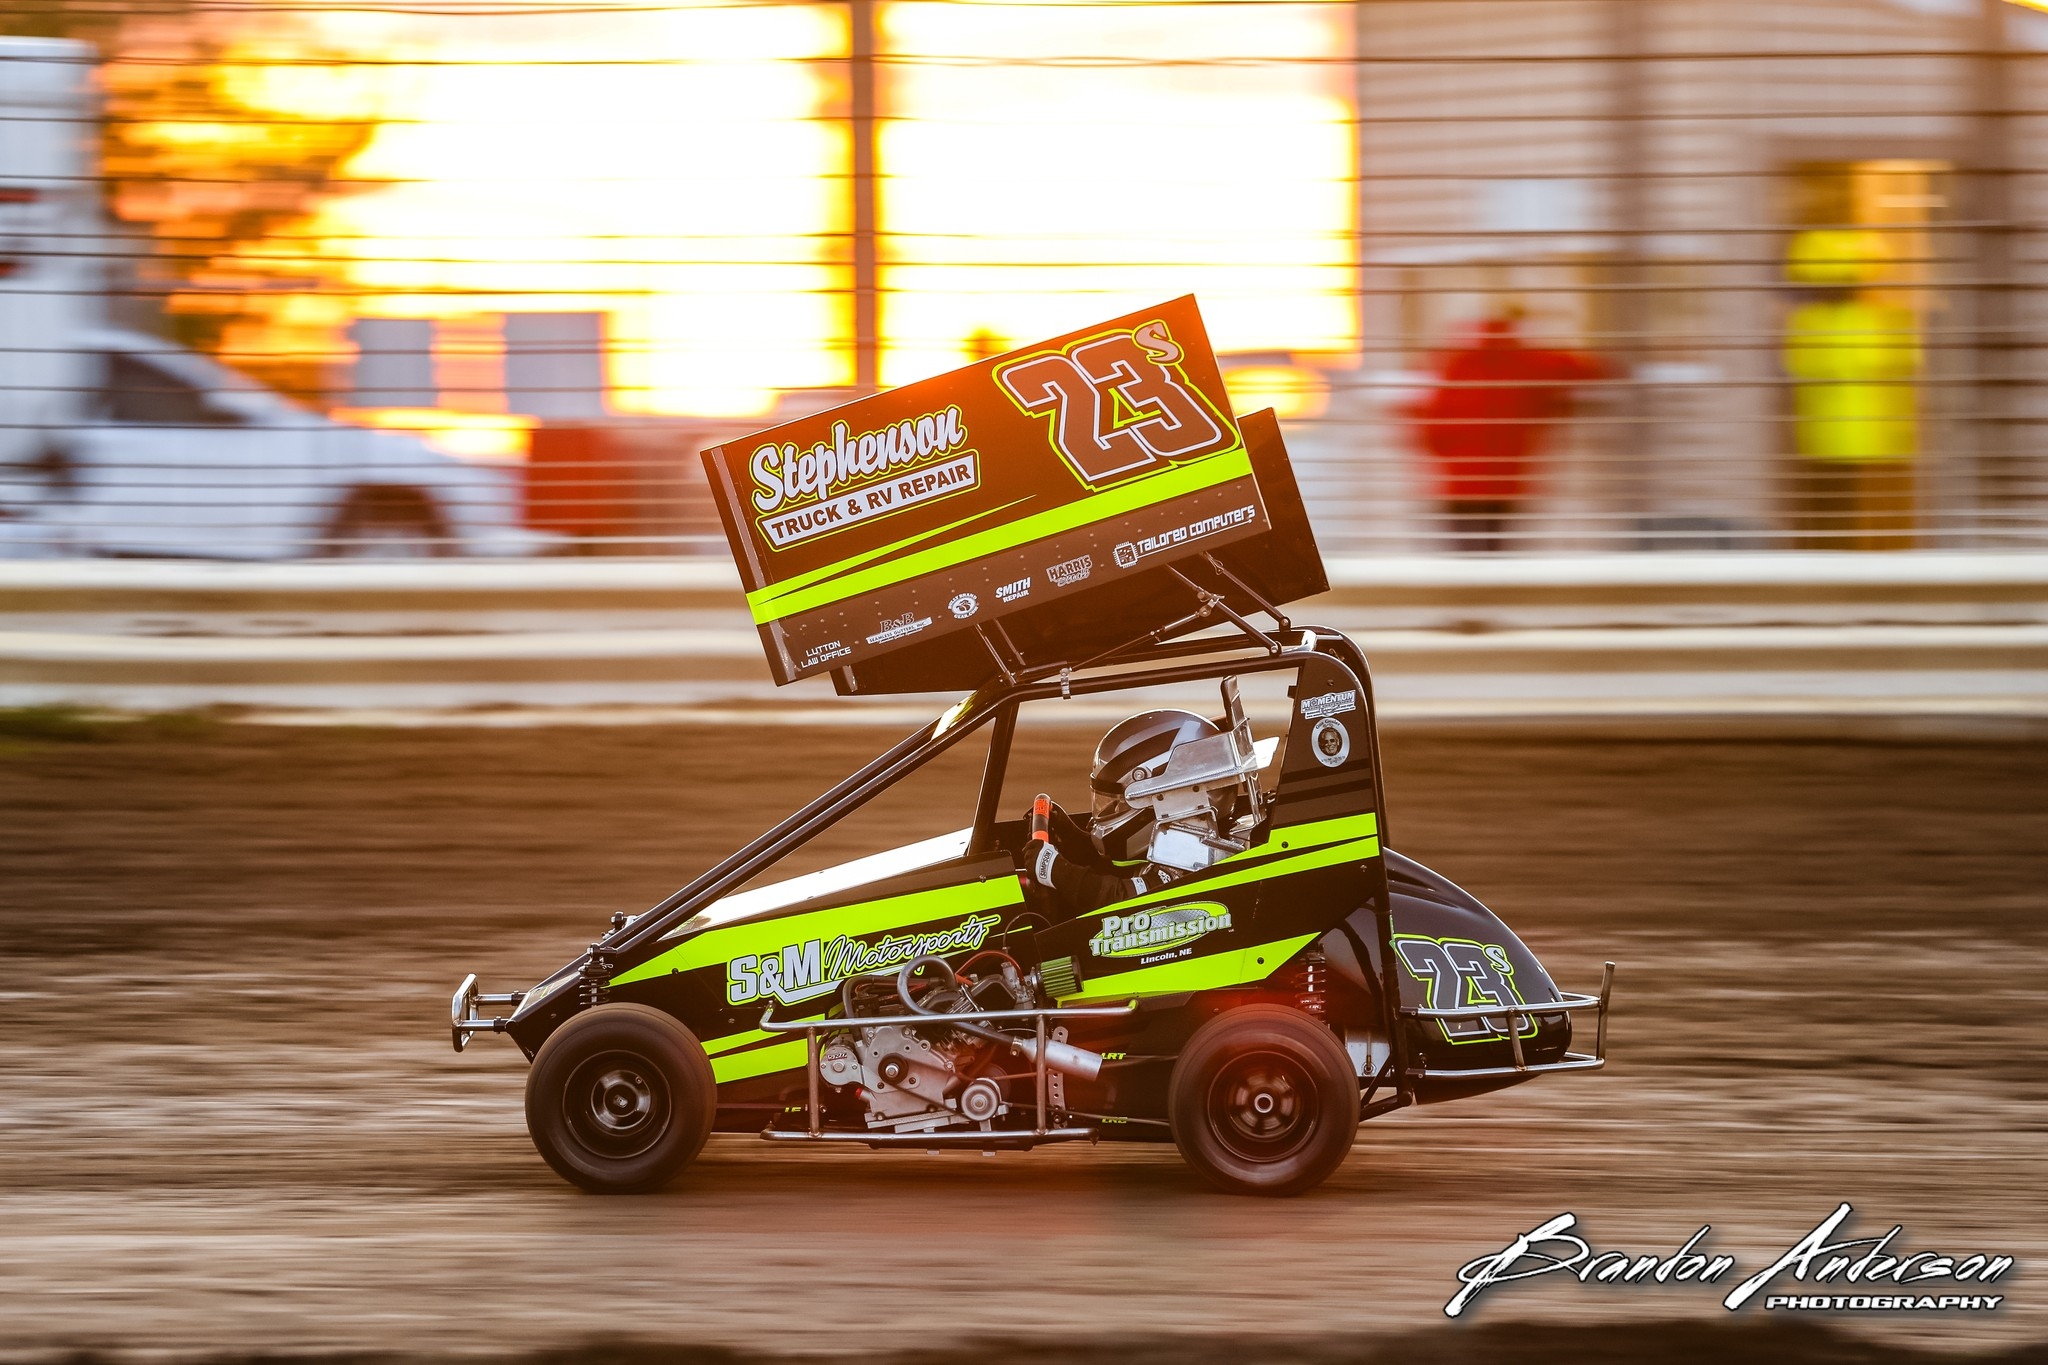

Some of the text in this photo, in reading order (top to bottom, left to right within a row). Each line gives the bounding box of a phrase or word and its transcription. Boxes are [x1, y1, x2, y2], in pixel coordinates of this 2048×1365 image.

[751, 407, 964, 511] Stephenson
[771, 463, 972, 539] TRUCK & RV REPAIR
[1047, 556, 1092, 580] HARRIS
[995, 577, 1031, 599] SMITH
[1002, 590, 1030, 603] REPAIR
[879, 612, 915, 633] B&B
[800, 646, 852, 669] LAW OFFICE
[805, 640, 841, 658] LUTTON
[1301, 691, 1355, 709] MOMENTUM
[1040, 850, 1052, 878] SIMPSON
[1089, 912, 1232, 956] Transmission
[1102, 912, 1151, 938] Pro
[729, 915, 999, 1003] S&M Motorsports
[1179, 947, 1193, 957] NE
